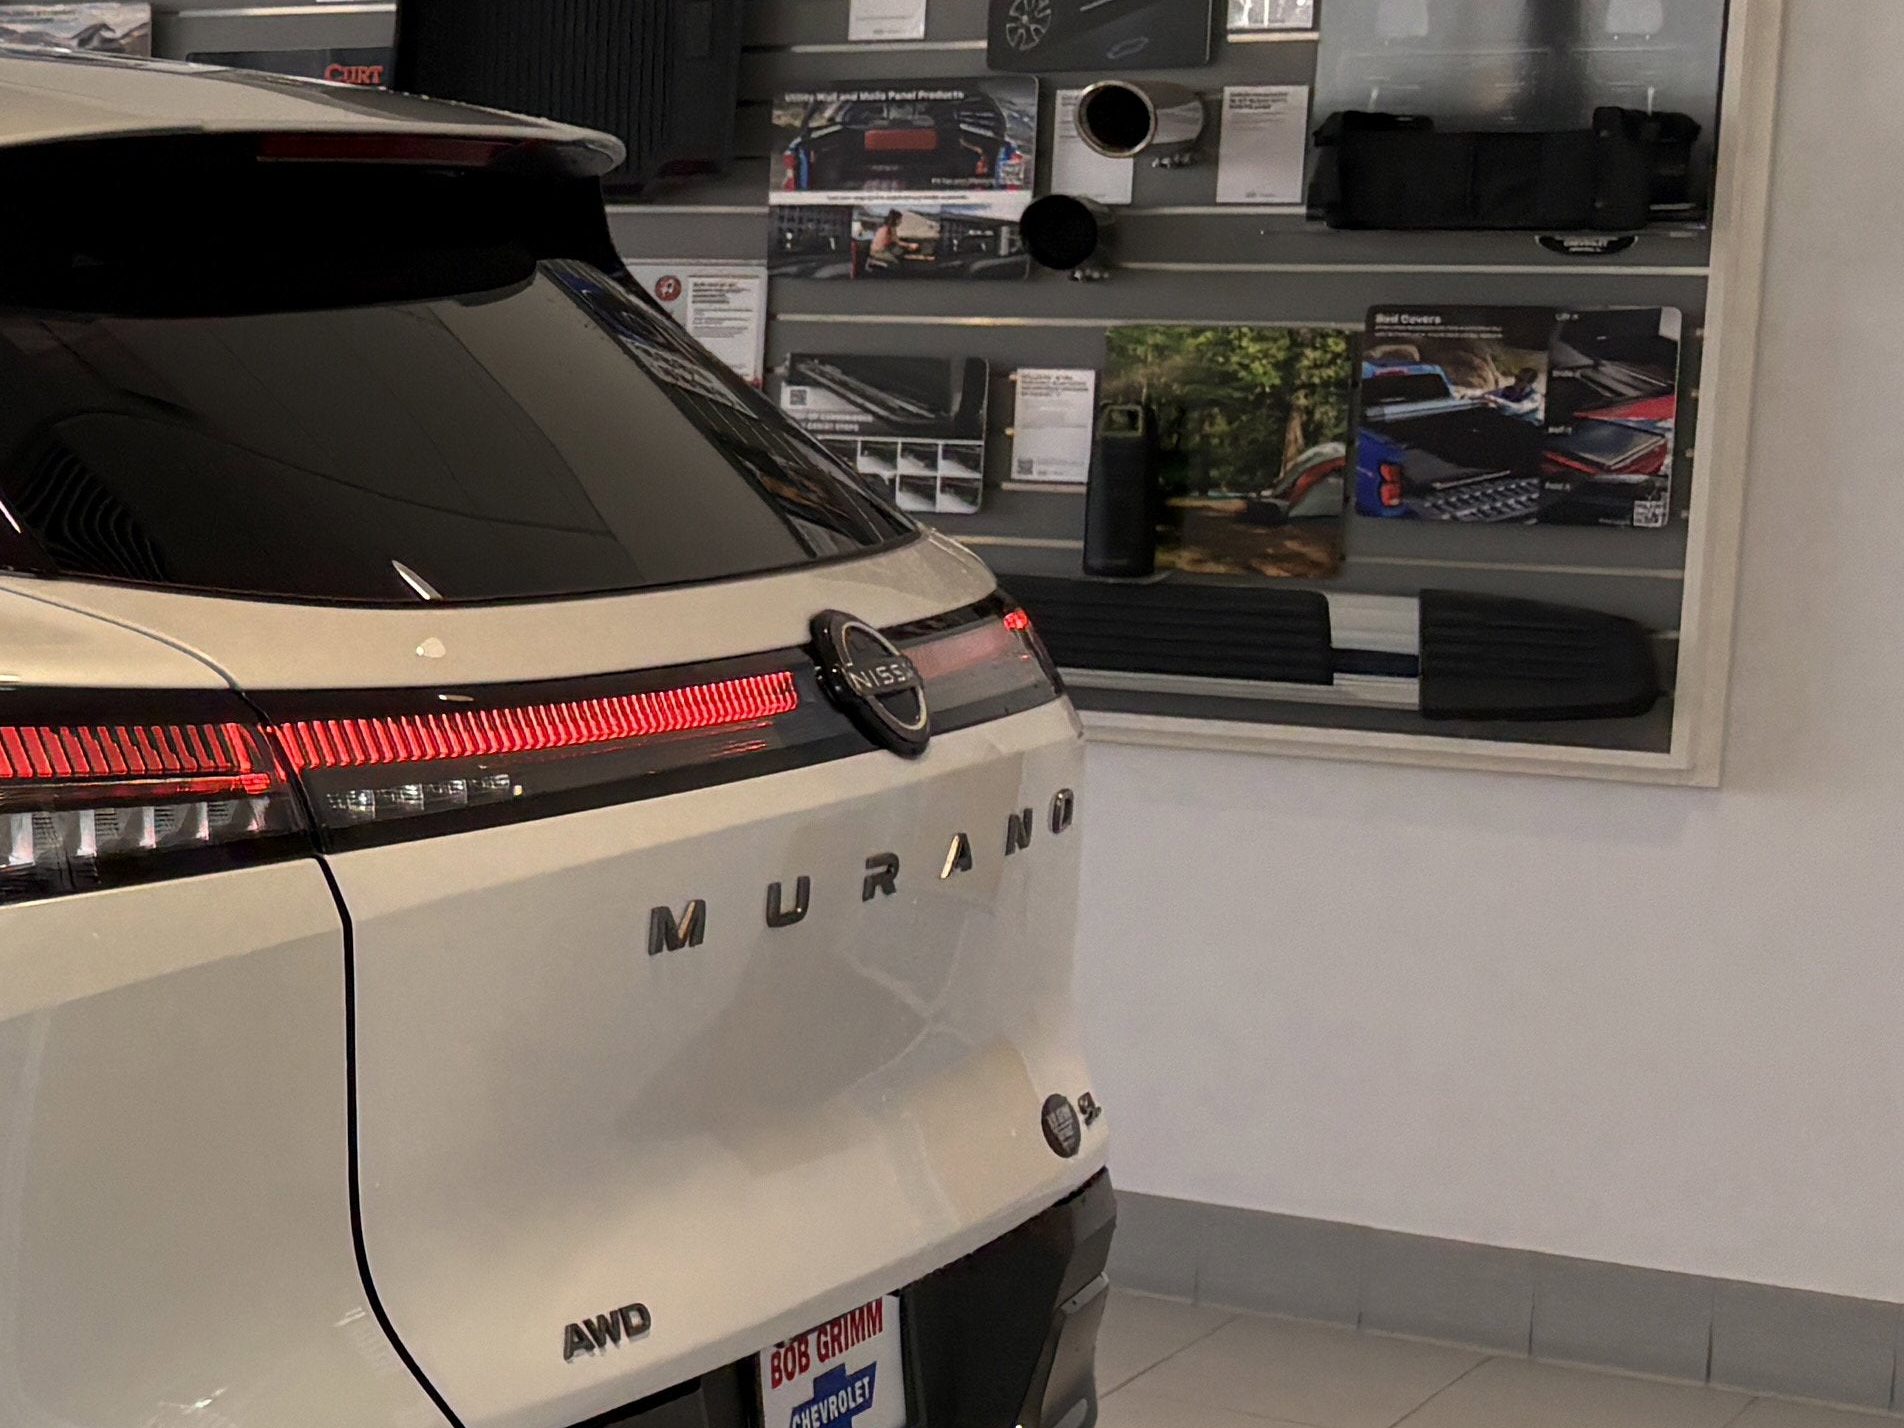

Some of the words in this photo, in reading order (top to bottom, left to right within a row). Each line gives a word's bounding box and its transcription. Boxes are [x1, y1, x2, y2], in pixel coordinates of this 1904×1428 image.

[324, 63, 383, 84] CURT
[1400, 314, 1442, 325] Covers
[648, 788, 1074, 956] MURANO
[563, 1302, 652, 1363] AWD
[771, 1336, 811, 1390] BOB
[817, 1297, 884, 1364] GRIMM
